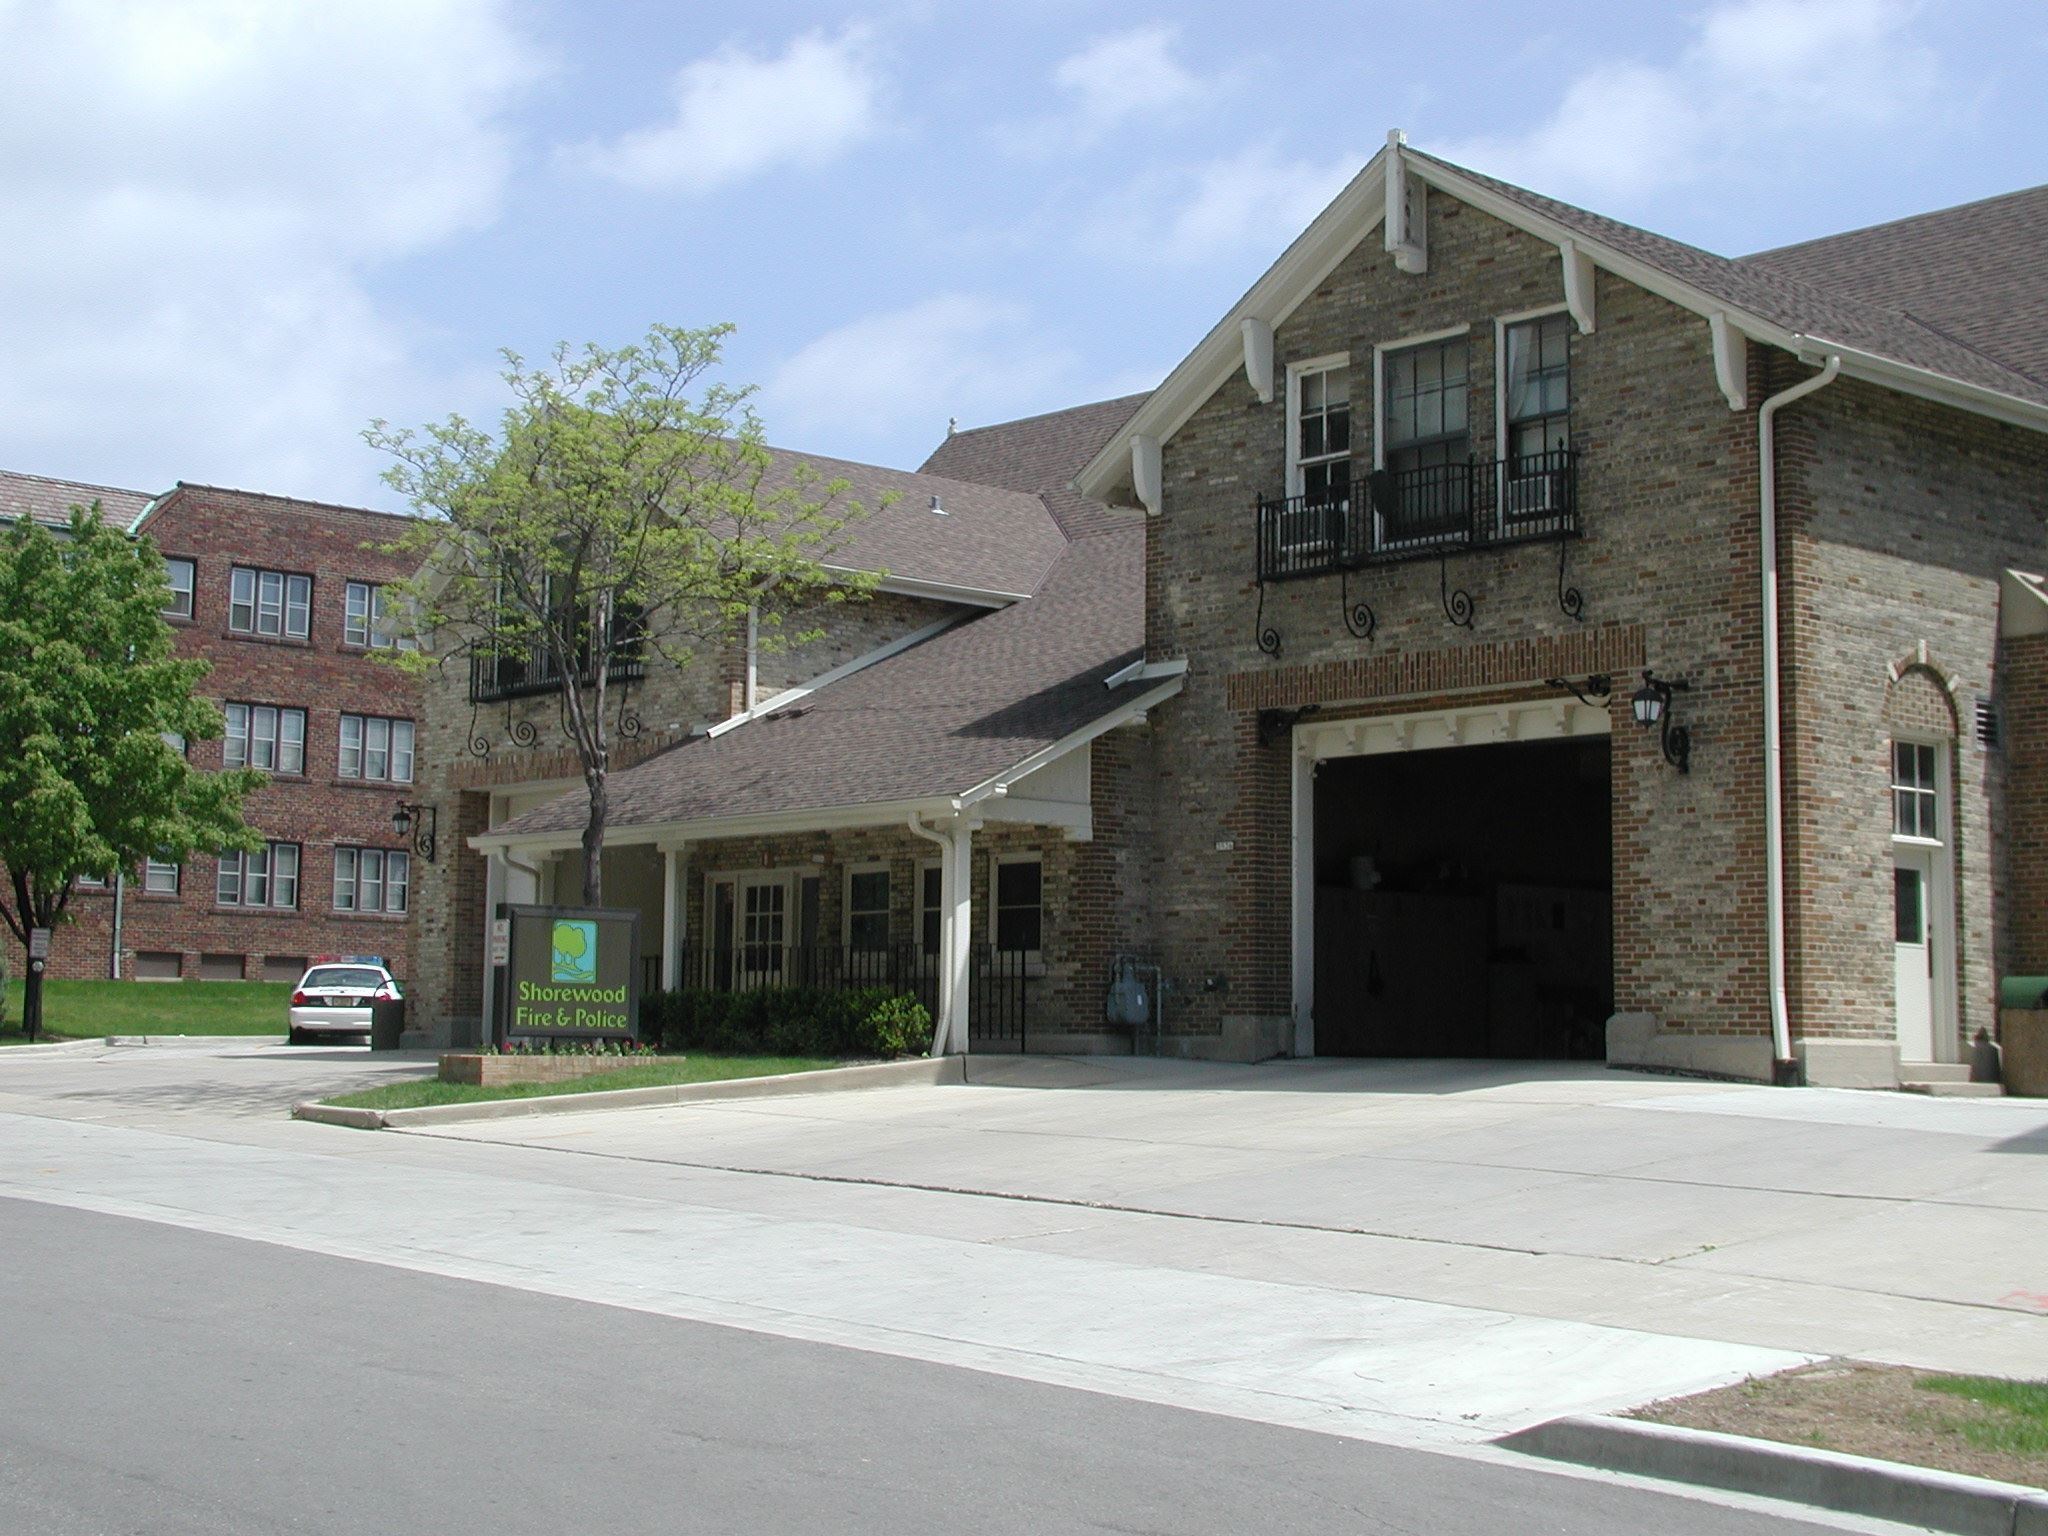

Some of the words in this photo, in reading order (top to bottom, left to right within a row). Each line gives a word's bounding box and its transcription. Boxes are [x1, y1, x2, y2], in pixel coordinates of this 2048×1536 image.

[519, 981, 626, 1003] Shorewood
[516, 1006, 552, 1026] Fire
[557, 1007, 571, 1026] &
[575, 1008, 627, 1027] Police
